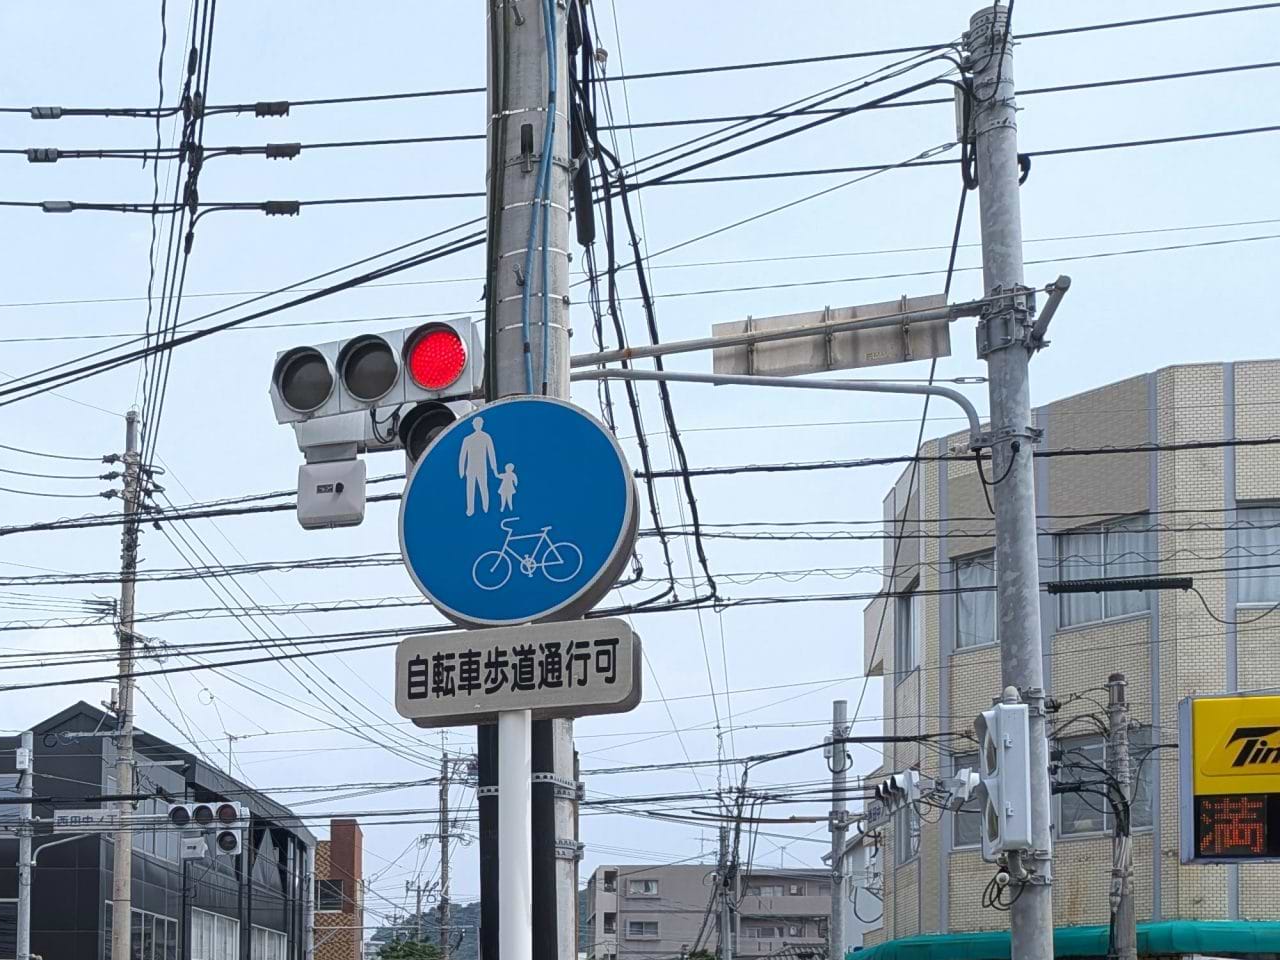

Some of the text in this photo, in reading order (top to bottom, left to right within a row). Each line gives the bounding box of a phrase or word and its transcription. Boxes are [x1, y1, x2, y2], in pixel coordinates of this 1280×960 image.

[407, 637, 620, 700] 自転車歩道通行可
[1200, 797, 1263, 854] 満
